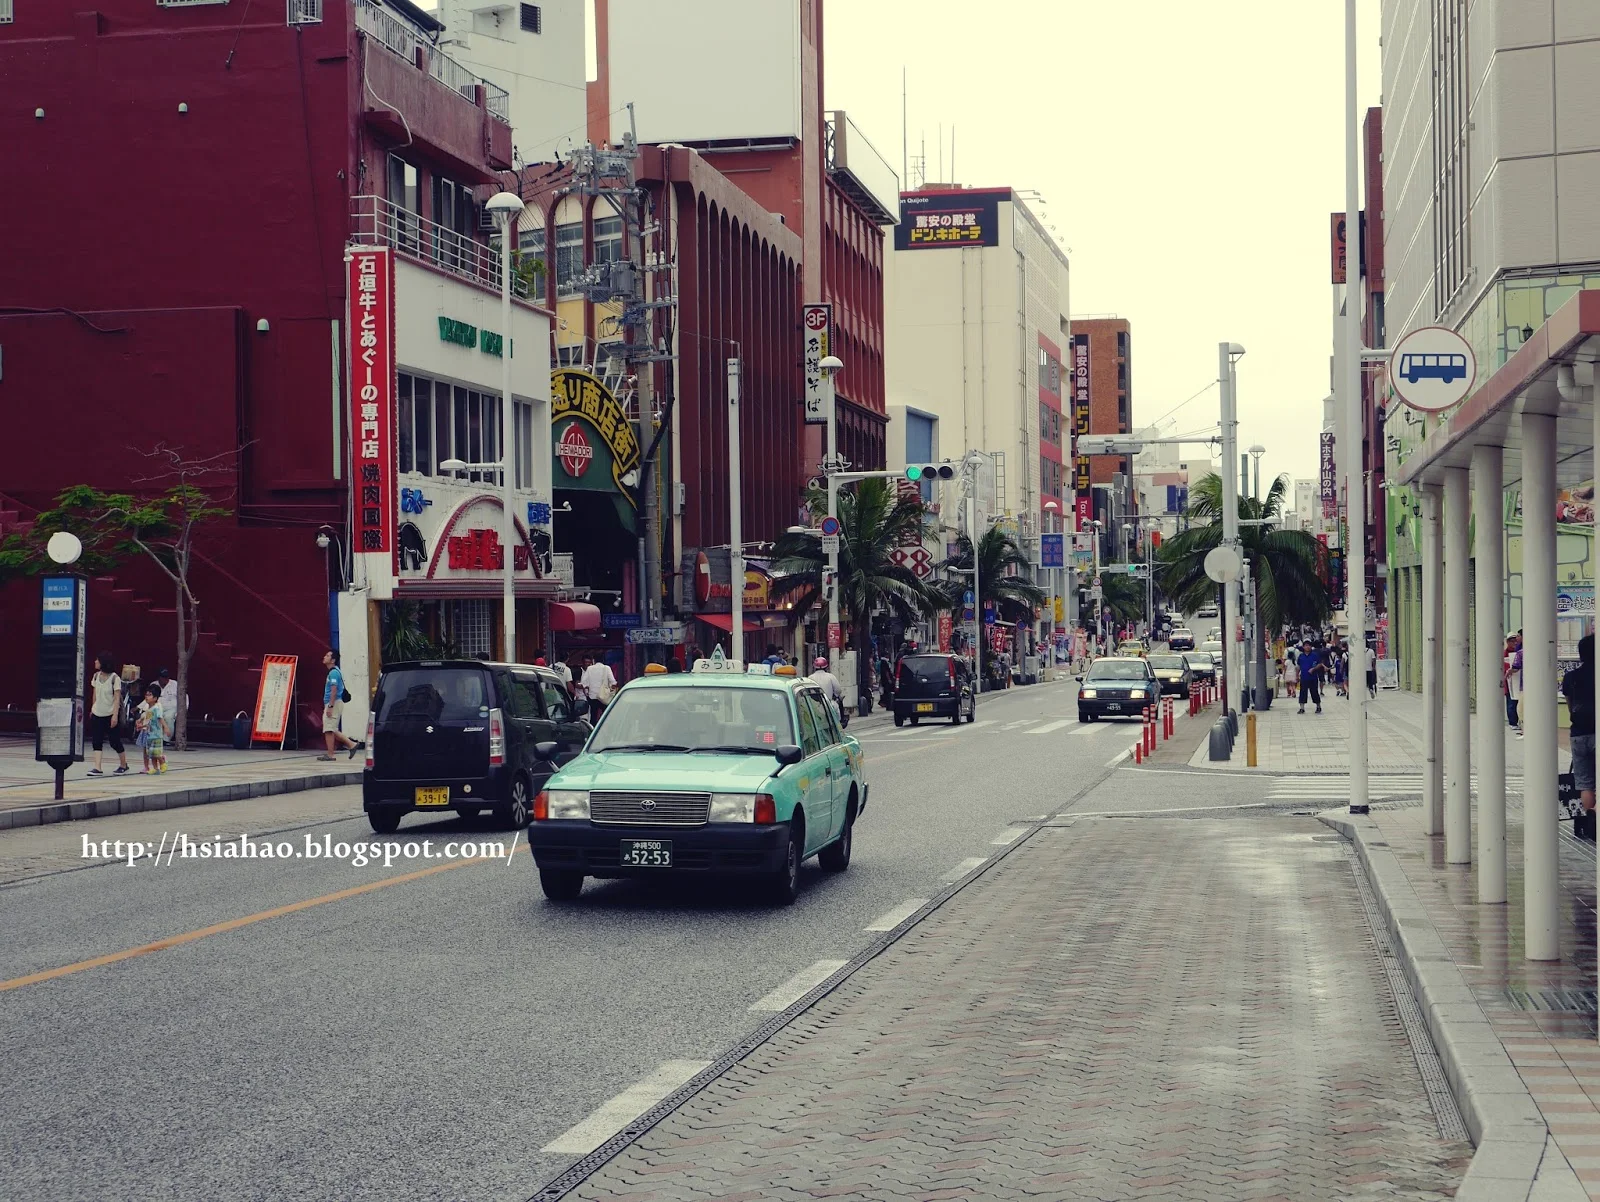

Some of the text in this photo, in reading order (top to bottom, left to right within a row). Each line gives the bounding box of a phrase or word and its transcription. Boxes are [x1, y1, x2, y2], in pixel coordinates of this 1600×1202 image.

[916, 213, 976, 228] 驚安の殿堂
[806, 312, 826, 327] 3F
[358, 255, 379, 459] 石垣牛とあぐーの専門店
[806, 337, 822, 412] 名護そば
[1322, 445, 1332, 497] ホテル山の内
[1080, 500, 1088, 514] Tax
[701, 660, 735, 670] みつい
[422, 794, 448, 804] 39-19
[632, 842, 661, 850] 沖縄500
[632, 850, 670, 864] 52-53
